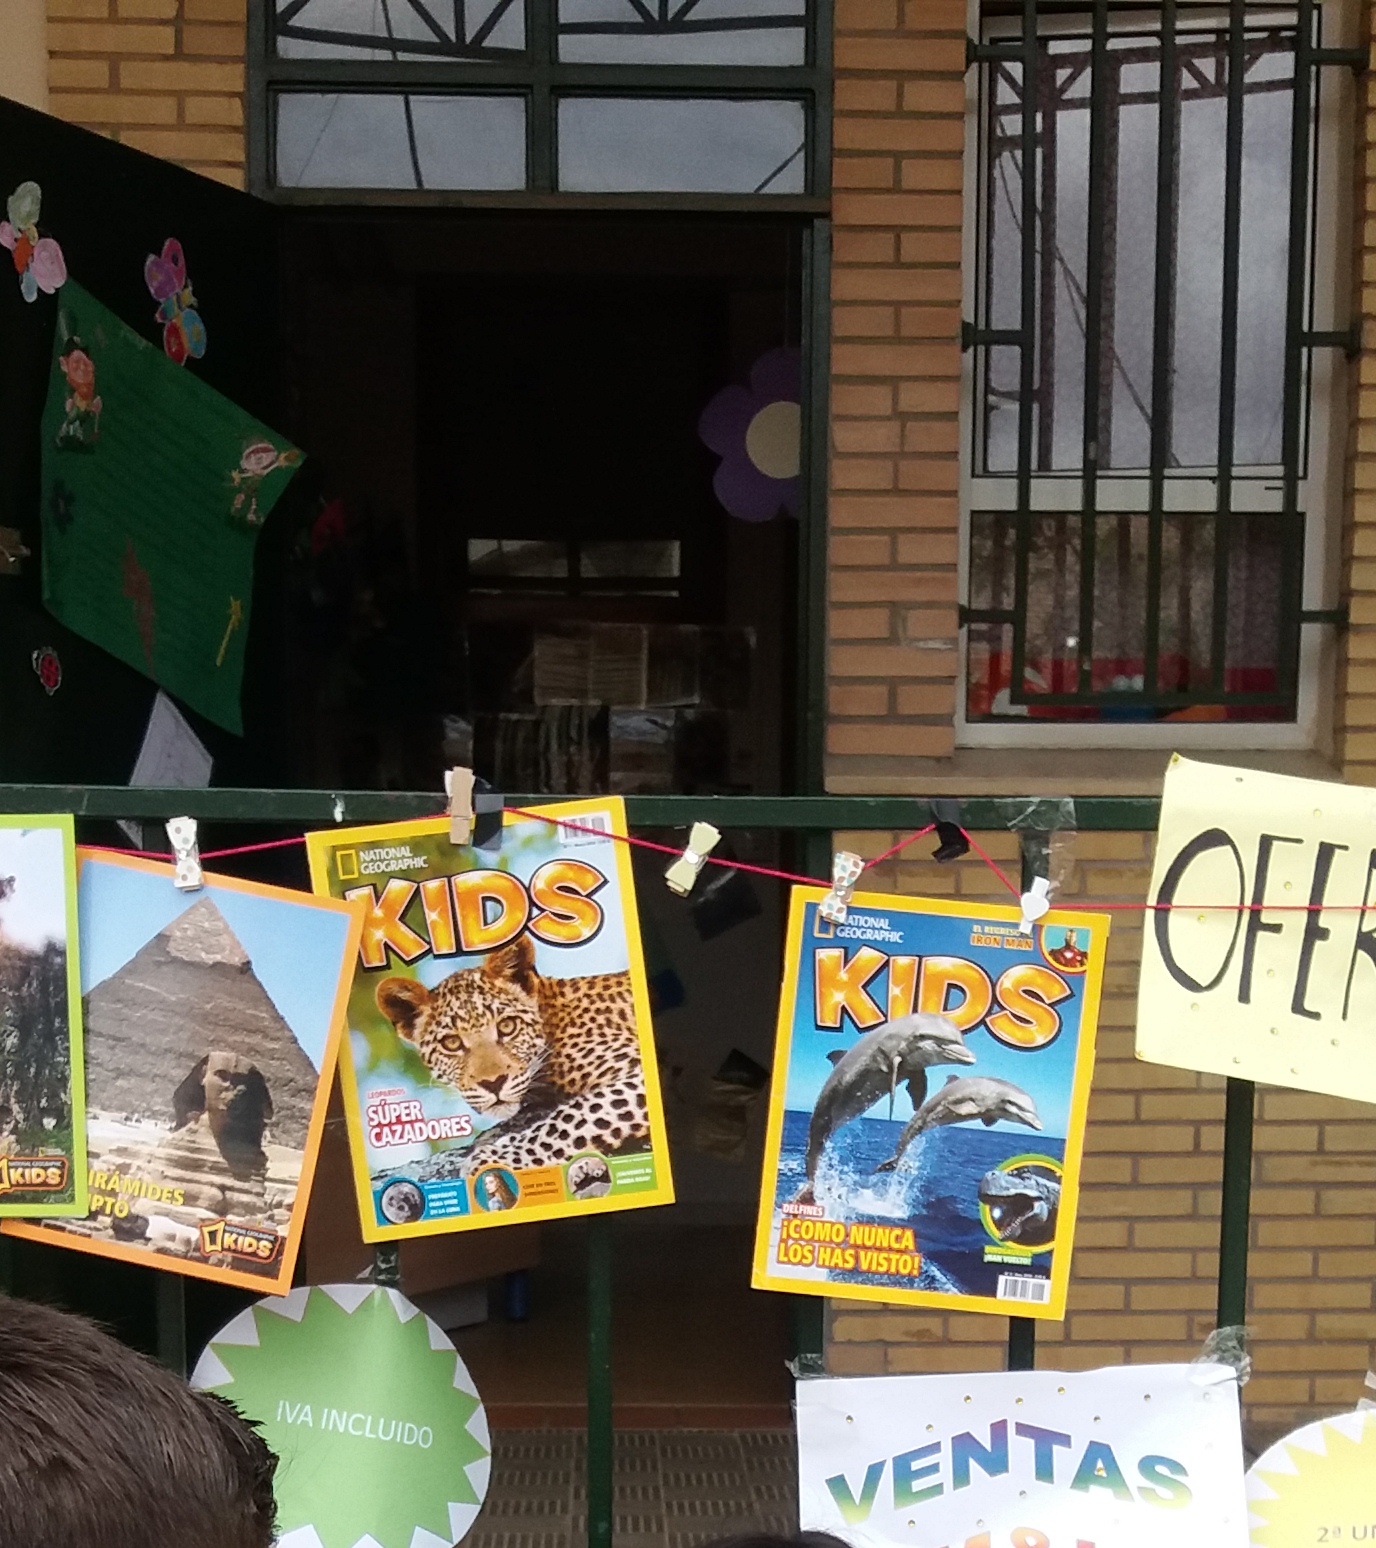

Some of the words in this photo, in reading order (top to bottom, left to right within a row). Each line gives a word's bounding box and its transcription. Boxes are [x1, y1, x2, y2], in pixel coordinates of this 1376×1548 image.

[359, 846, 414, 862] NATIONAL
[360, 855, 429, 875] GEOGRAPHIC
[345, 859, 609, 970] KIDS
[843, 914, 891, 931] ATIONAL
[835, 926, 905, 944] GEOGRAPHIC
[970, 933, 1002, 949] IRON
[1004, 936, 1034, 951] MAN
[814, 944, 1076, 1050] KIDS
[367, 1099, 423, 1127] SÚPER
[369, 1115, 473, 1148] CAZADORES
[9, 1167, 62, 1185] KIDS
[88, 1169, 185, 1207] IRÁMIDES
[782, 1203, 824, 1217] DELFINES
[223, 1232, 273, 1258] KIDS
[781, 1218, 846, 1244] ¡COMO
[849, 1224, 916, 1251] NUNCA
[777, 1242, 814, 1265] LOS
[817, 1245, 856, 1270] HAS
[857, 1249, 921, 1277] VISTO!
[276, 1400, 314, 1428] IVA
[320, 1408, 433, 1449] INCLUIDO
[824, 1418, 1194, 1527] VENTAS
